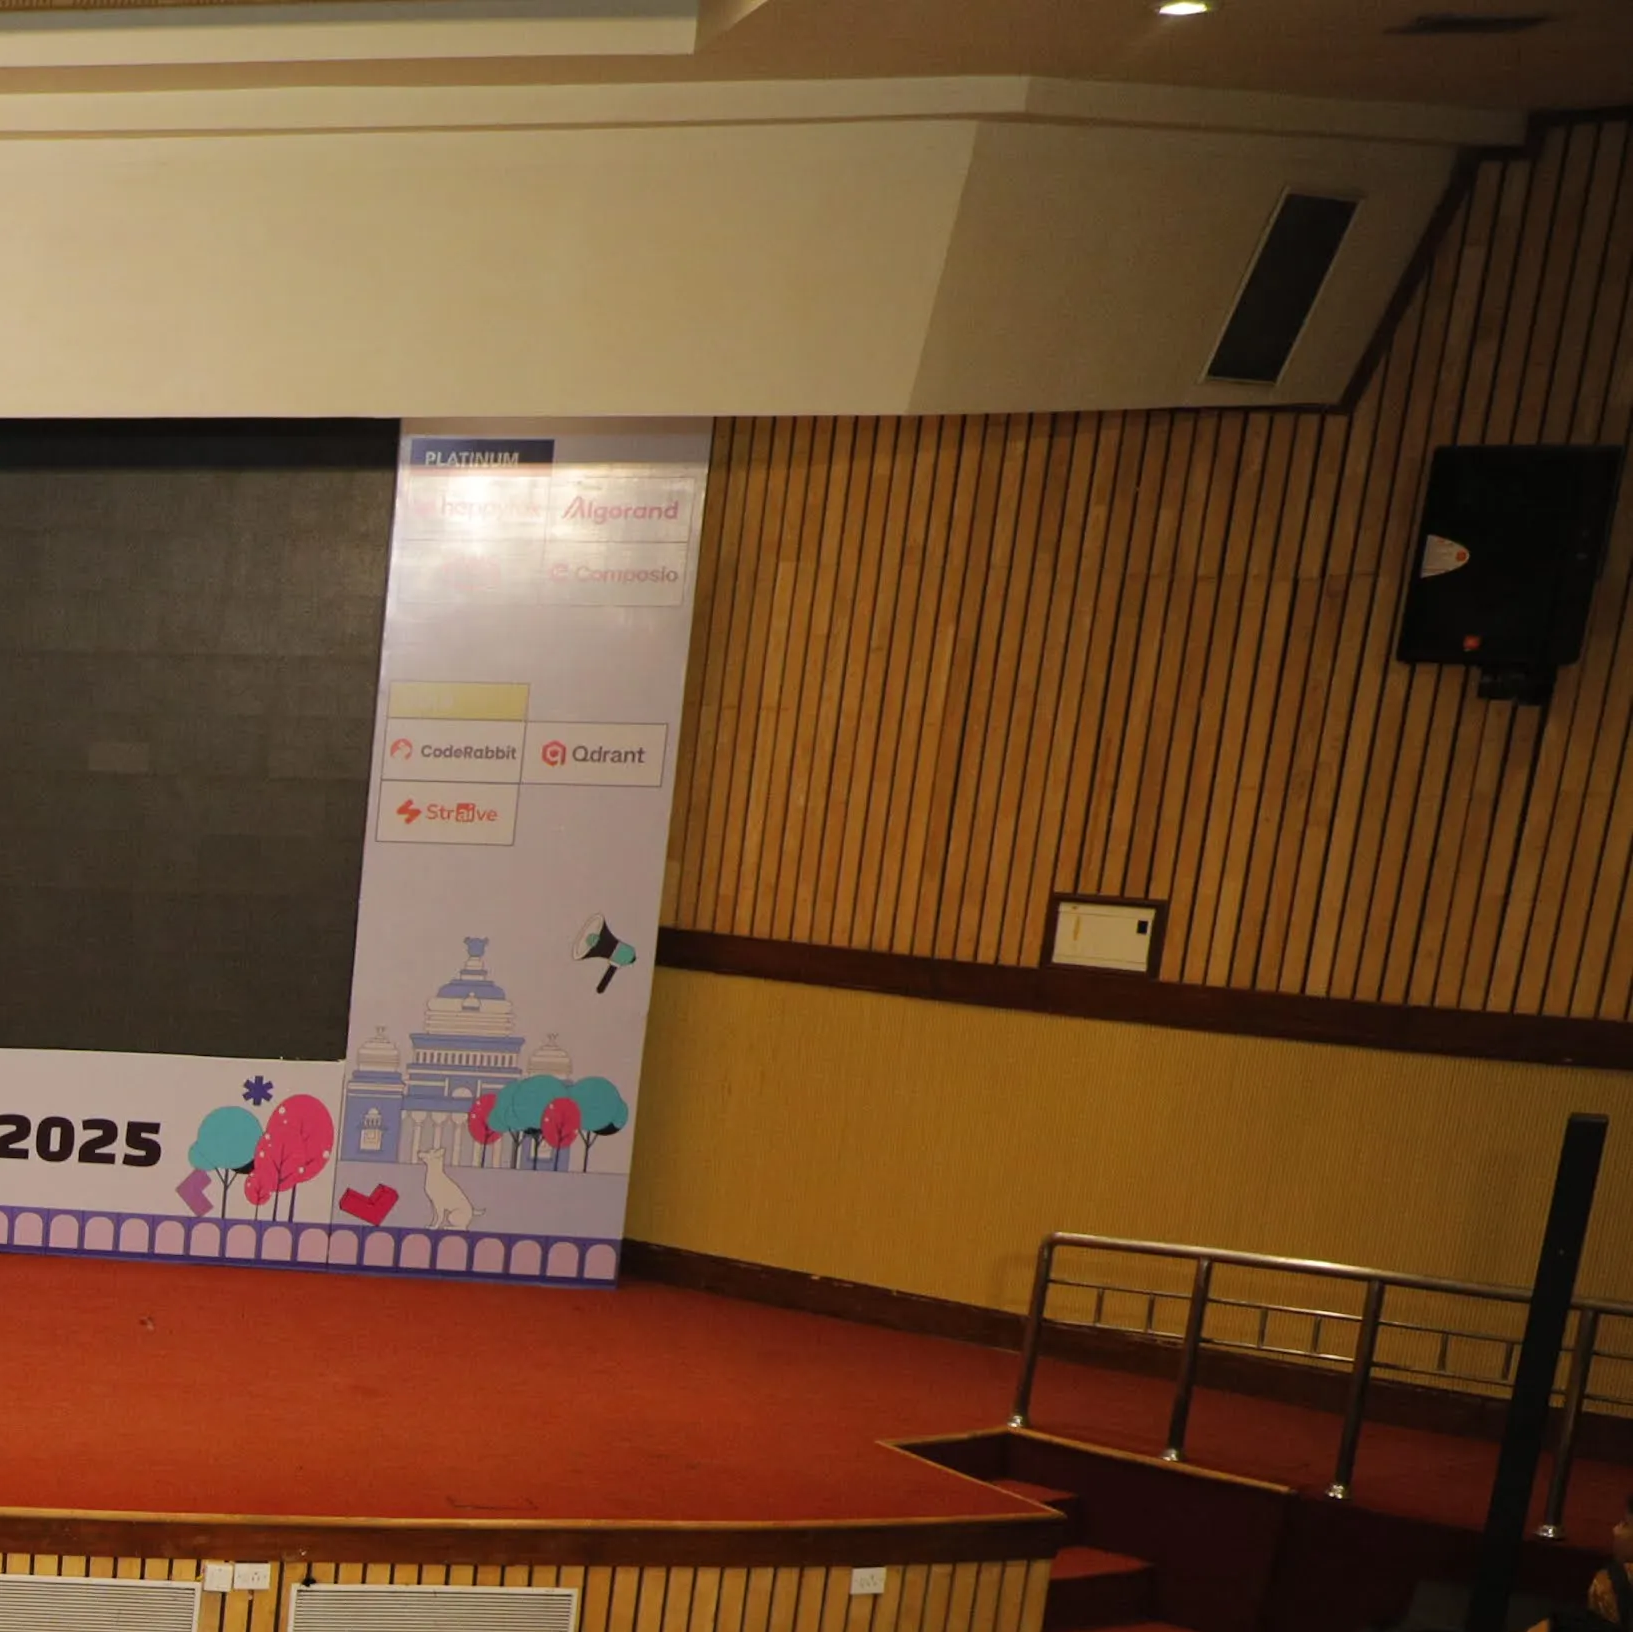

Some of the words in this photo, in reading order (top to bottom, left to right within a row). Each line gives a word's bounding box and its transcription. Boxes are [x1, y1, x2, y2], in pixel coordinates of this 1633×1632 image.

[424, 450, 520, 468] PLATINUM
[561, 494, 680, 526] Algorand
[574, 564, 680, 588] Composio
[419, 743, 518, 762] CodeRabbit
[571, 744, 646, 767] Qdrant
[425, 802, 499, 824] Straive
